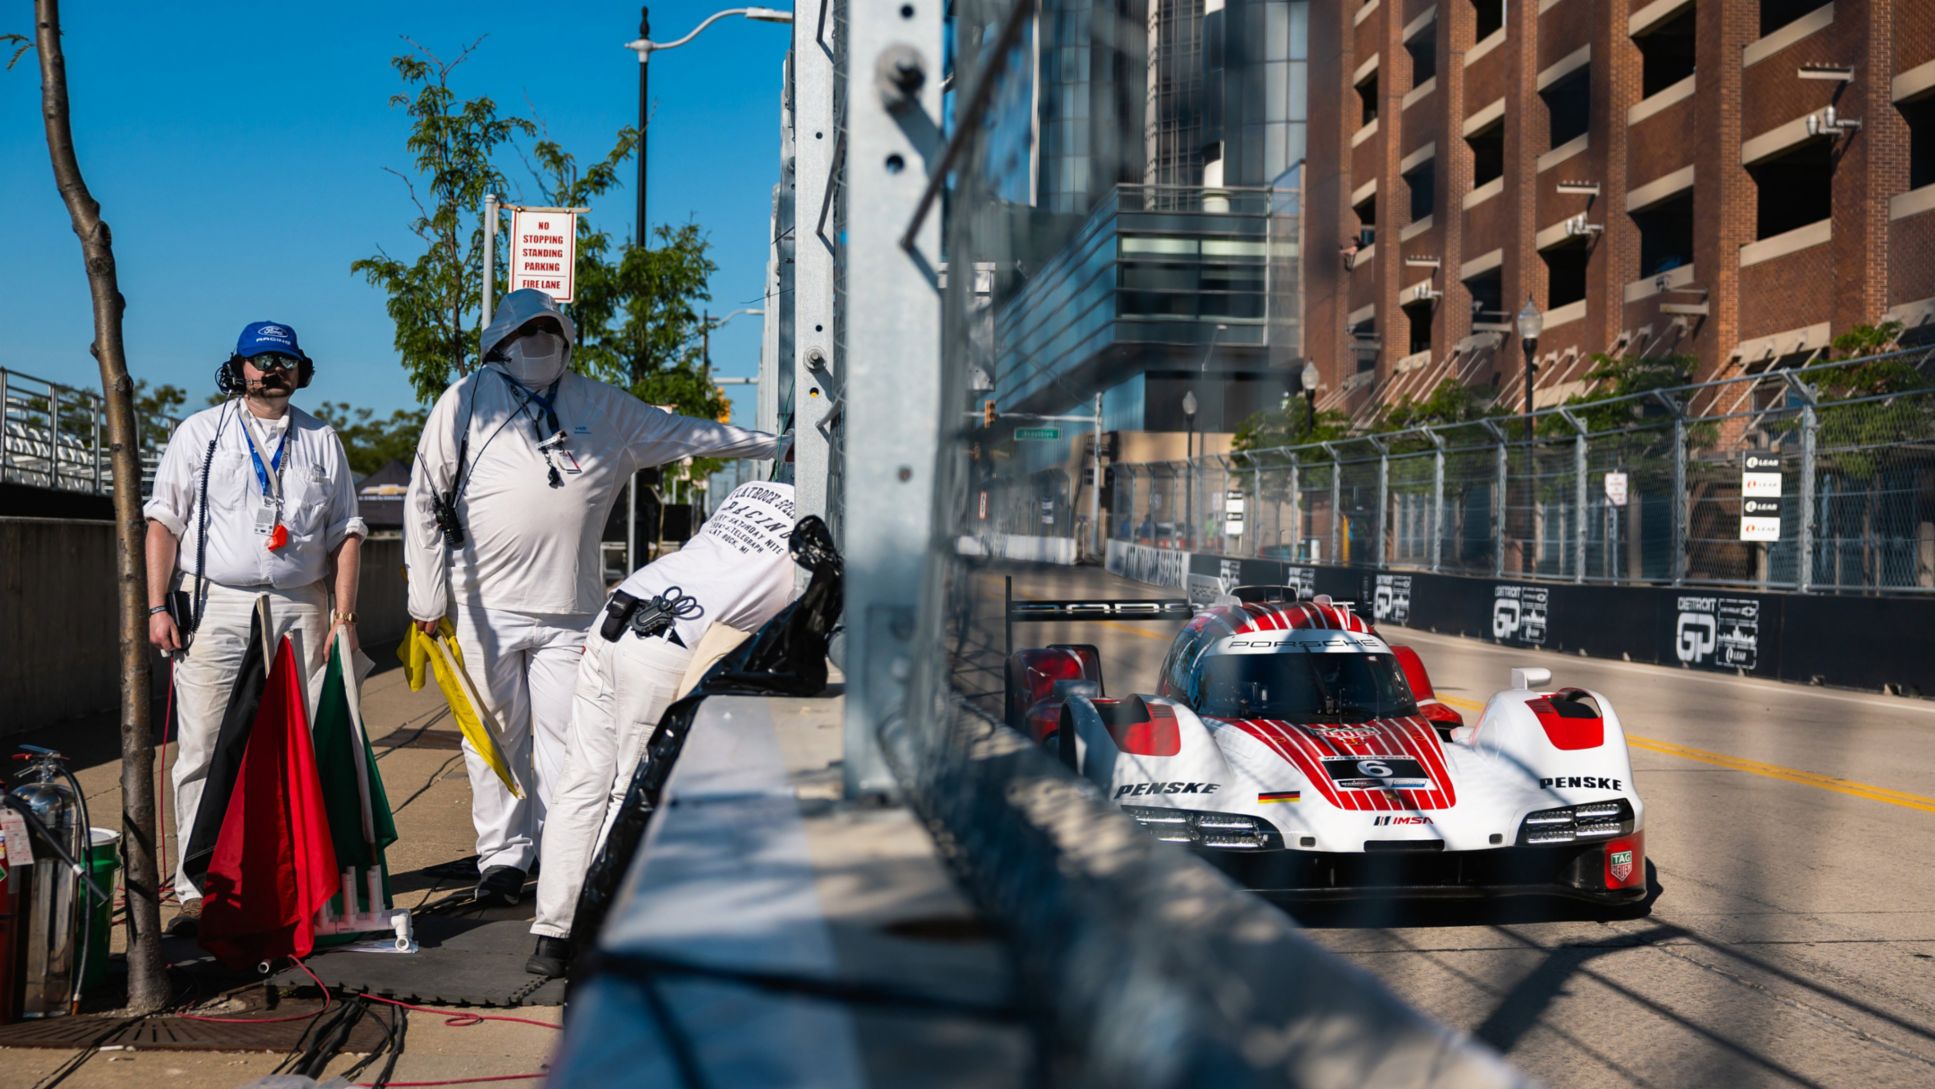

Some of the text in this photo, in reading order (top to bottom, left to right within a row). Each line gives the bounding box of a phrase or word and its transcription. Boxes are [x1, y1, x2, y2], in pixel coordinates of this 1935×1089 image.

[538, 221, 550, 230] NO
[523, 234, 564, 244] STOPPING
[522, 248, 563, 258] STANDING
[524, 262, 560, 271] PARKING
[522, 279, 561, 289] FIRE LANE
[1758, 459, 1779, 467] LEAR
[1757, 503, 1778, 511] LEAR
[730, 527, 764, 554] TELEGRAPH
[738, 545, 750, 555] MI
[764, 538, 785, 555] NITE
[1677, 597, 1717, 612] DETROIT
[1493, 599, 1520, 639] GP
[1676, 612, 1716, 663] GP
[1228, 640, 1379, 649] PORSCHE
[1357, 760, 1394, 778] 6
[1540, 777, 1622, 791] PENSKE
[1113, 782, 1221, 799] PENSKE
[1392, 816, 1434, 825] IMSA
[1613, 854, 1631, 864] TAG
